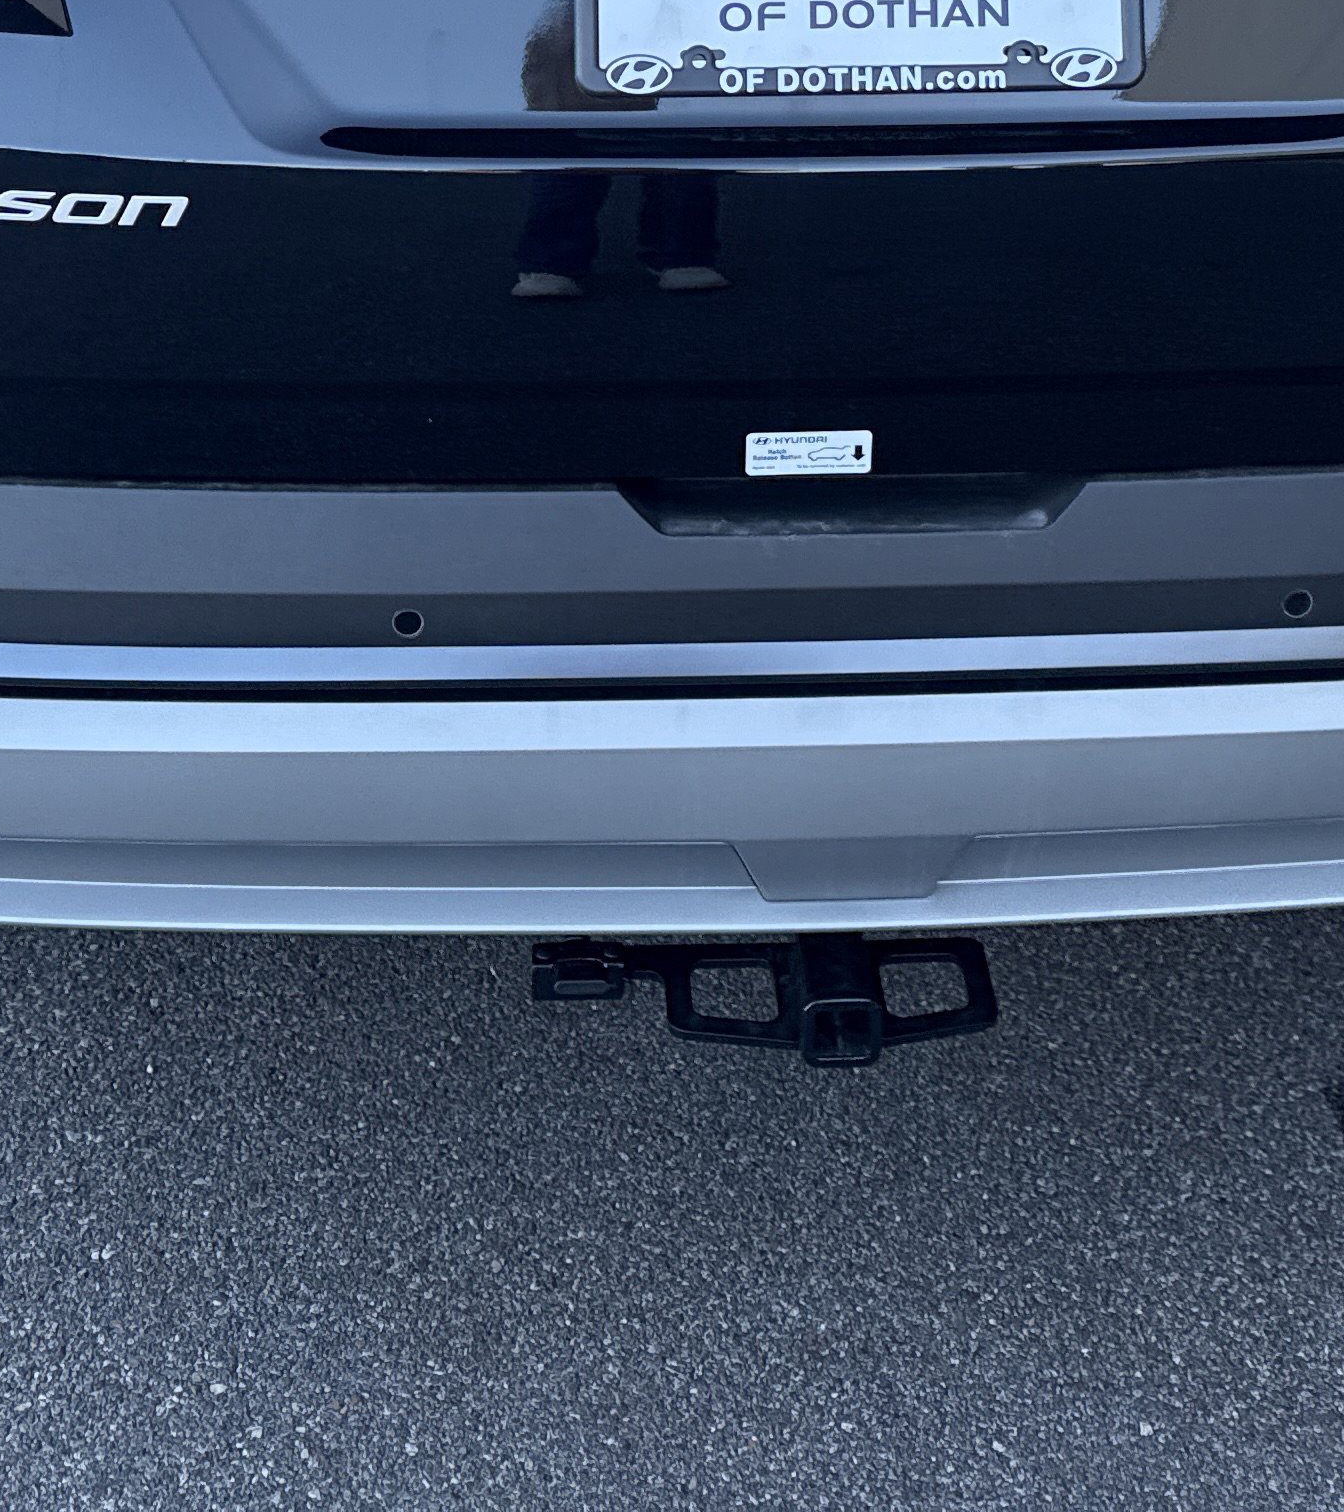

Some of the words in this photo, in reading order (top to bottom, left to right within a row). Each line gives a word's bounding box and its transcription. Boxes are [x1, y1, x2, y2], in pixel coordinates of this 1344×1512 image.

[718, 0, 787, 32] OF
[719, 66, 768, 93] OF
[776, 64, 1007, 93] DOTHAN.com
[774, 436, 828, 445] HYUNDAI
